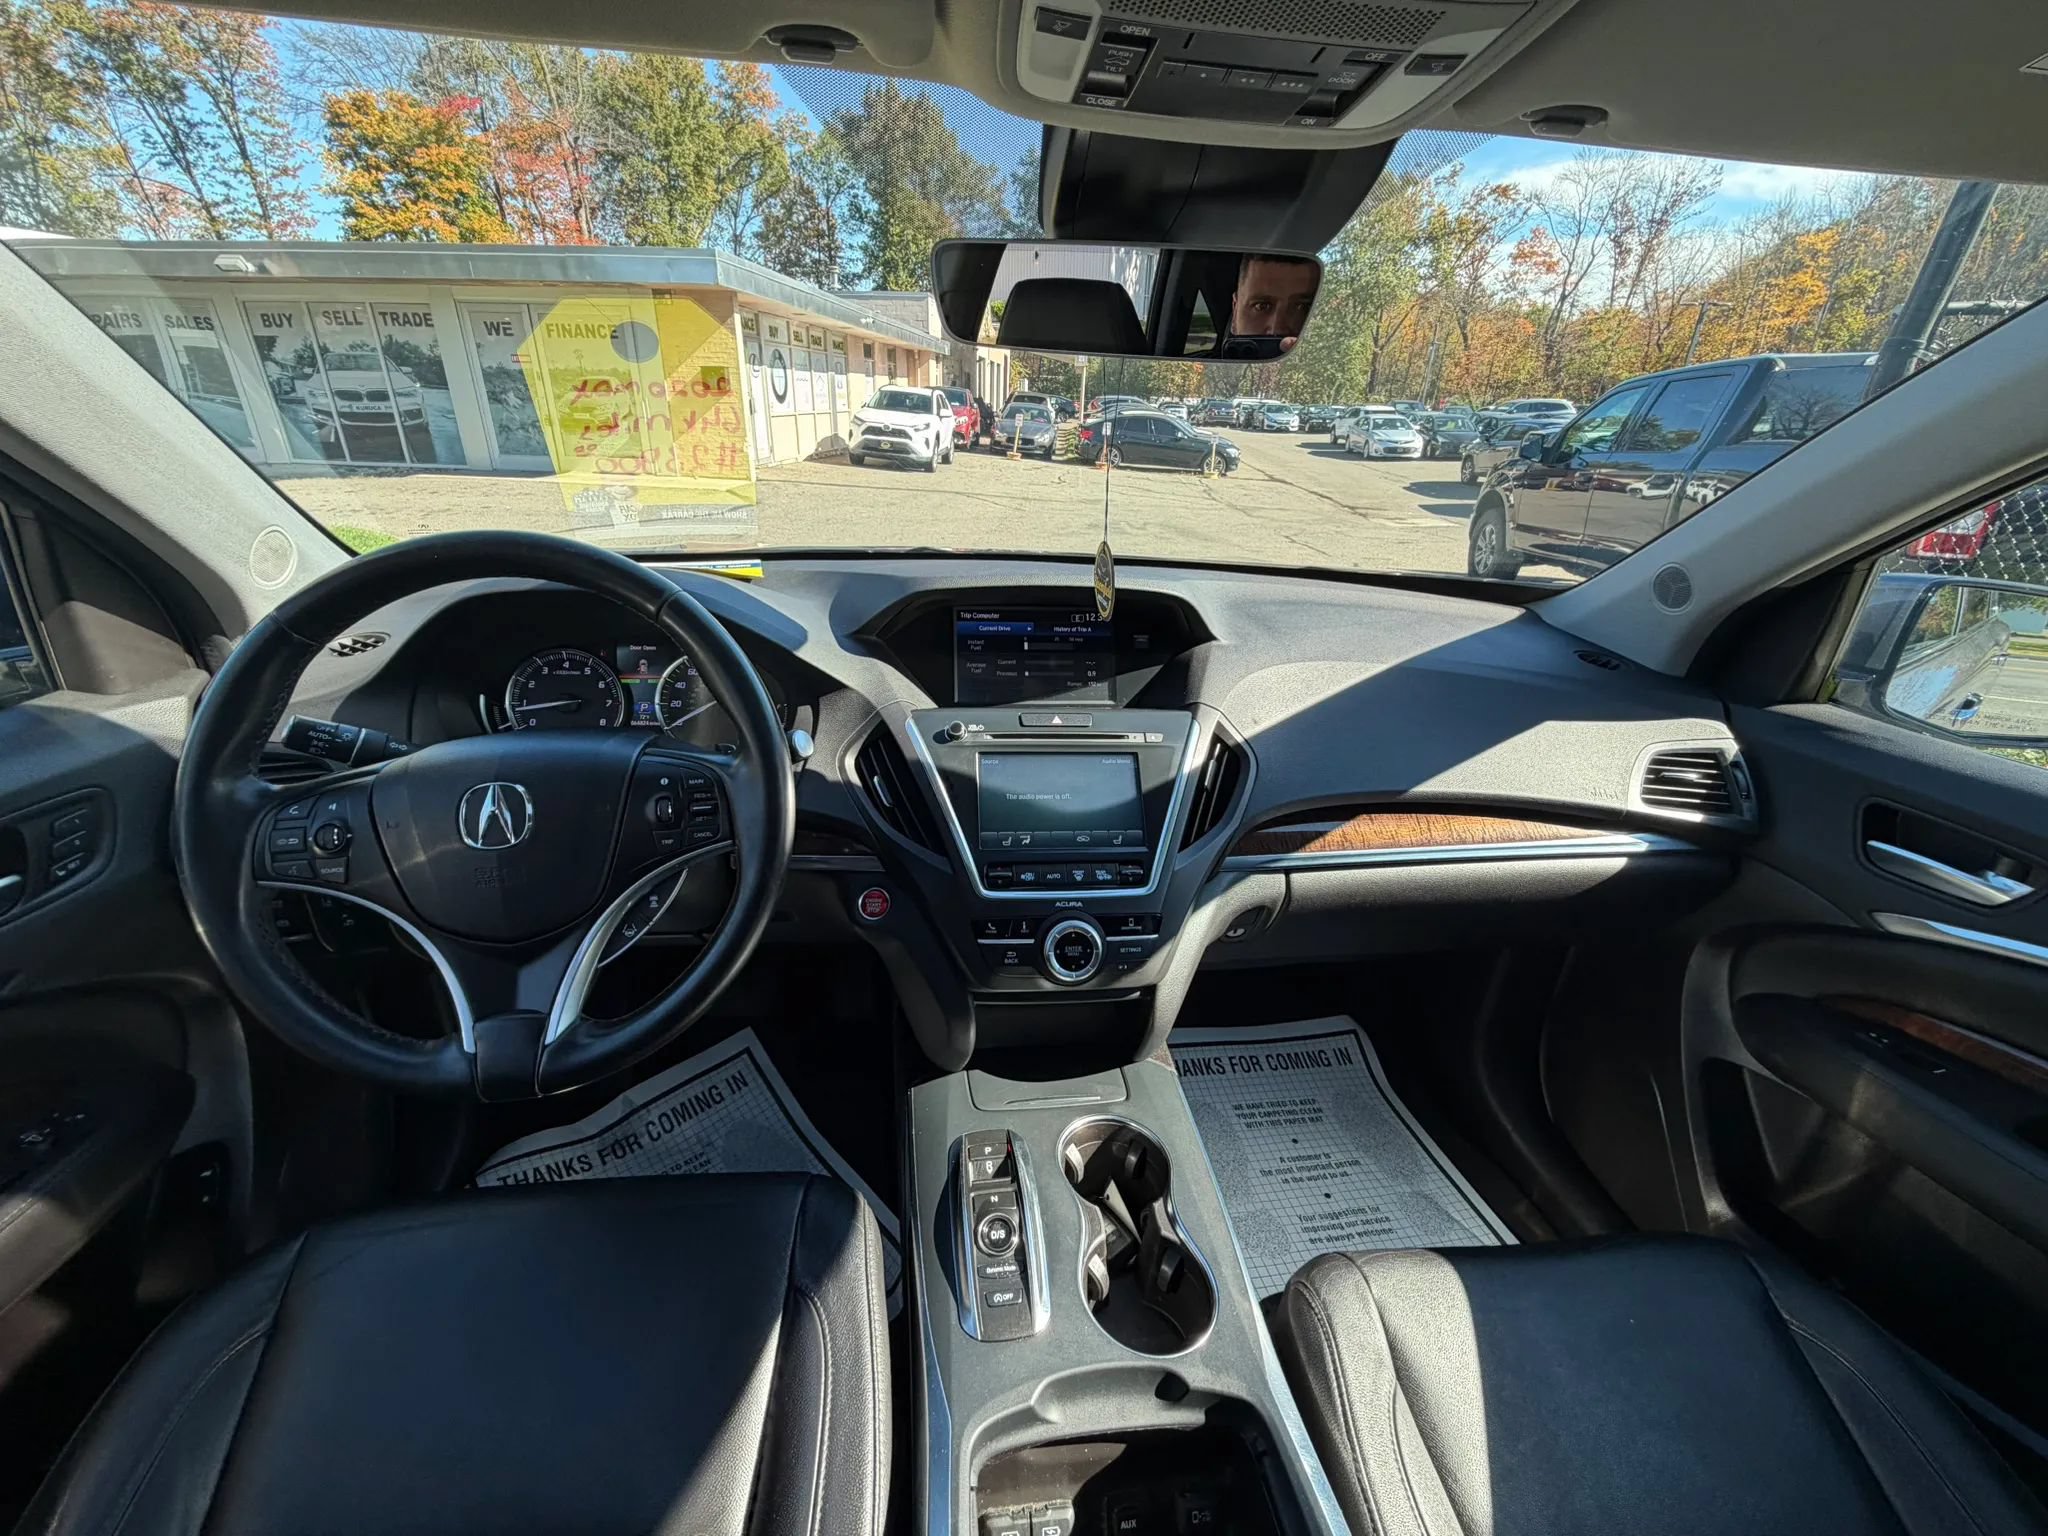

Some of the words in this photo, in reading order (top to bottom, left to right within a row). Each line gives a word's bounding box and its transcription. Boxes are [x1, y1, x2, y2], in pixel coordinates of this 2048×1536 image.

[1120, 25, 1151, 36] OPEN
[1108, 49, 1134, 58] PUSH
[1364, 52, 1387, 61] OFF
[1105, 65, 1123, 73] TILT
[1086, 96, 1117, 107] CLOSE
[1301, 118, 1318, 126] ON
[164, 314, 215, 331] SALES
[260, 313, 294, 328] BUY
[322, 310, 364, 326] SELL
[378, 311, 435, 327] TRADE
[483, 320, 515, 337] WE
[545, 322, 619, 340] FINANCE
[972, 612, 1000, 620] Computer
[598, 681, 605, 689] 6
[606, 699, 613, 707] 7
[641, 703, 649, 711] P
[670, 700, 682, 708] 20
[529, 718, 536, 726] 0
[600, 718, 607, 726] 8
[308, 730, 328, 740] AUTO
[1228, 1055, 1264, 1074] FOR
[1266, 1051, 1332, 1072] COMING
[1333, 1047, 1353, 1066] IN
[1232, 1103, 1244, 1111] WE
[1245, 1101, 1265, 1110] HAVE
[1265, 1099, 1288, 1109] TRIED
[1288, 1099, 1299, 1107] TO
[1299, 1098, 1317, 1106] KEEP
[597, 1132, 644, 1166] FOR
[646, 1089, 726, 1144] COMING
[726, 1069, 750, 1095] IN
[1235, 1112, 1258, 1120] YOUR
[1258, 1109, 1299, 1119] CARPETING
[1299, 1107, 1324, 1115] CLEAN
[1244, 1121, 1264, 1129] WITH
[1265, 1119, 1283, 1127] THIS
[1283, 1117, 1307, 1126] PAPER
[1307, 1115, 1324, 1123] MAT
[984, 1147, 992, 1155] P
[1280, 1156, 1287, 1164] A
[1286, 1153, 1322, 1163] customer
[1260, 1168, 1273, 1177] the
[1274, 1166, 1296, 1175] most
[1296, 1161, 1335, 1173] important
[1334, 1159, 1361, 1170] person
[1290, 1176, 1305, 1184] the
[1305, 1172, 1329, 1182] world
[991, 1195, 998, 1203] N
[1297, 1214, 1317, 1223] Your
[1318, 1207, 1368, 1221] suggestions
[1368, 1205, 1381, 1213] for
[1300, 1222, 1345, 1234] improving
[1344, 1220, 1359, 1229] our
[1360, 1215, 1391, 1226] service
[990, 1229, 1006, 1239] D/S
[1308, 1237, 1324, 1245] are
[1324, 1232, 1356, 1243] always
[986, 1266, 1004, 1274] Dynamic
[1002, 1292, 1014, 1301] OFF
[1120, 1518, 1137, 1529] AUX
